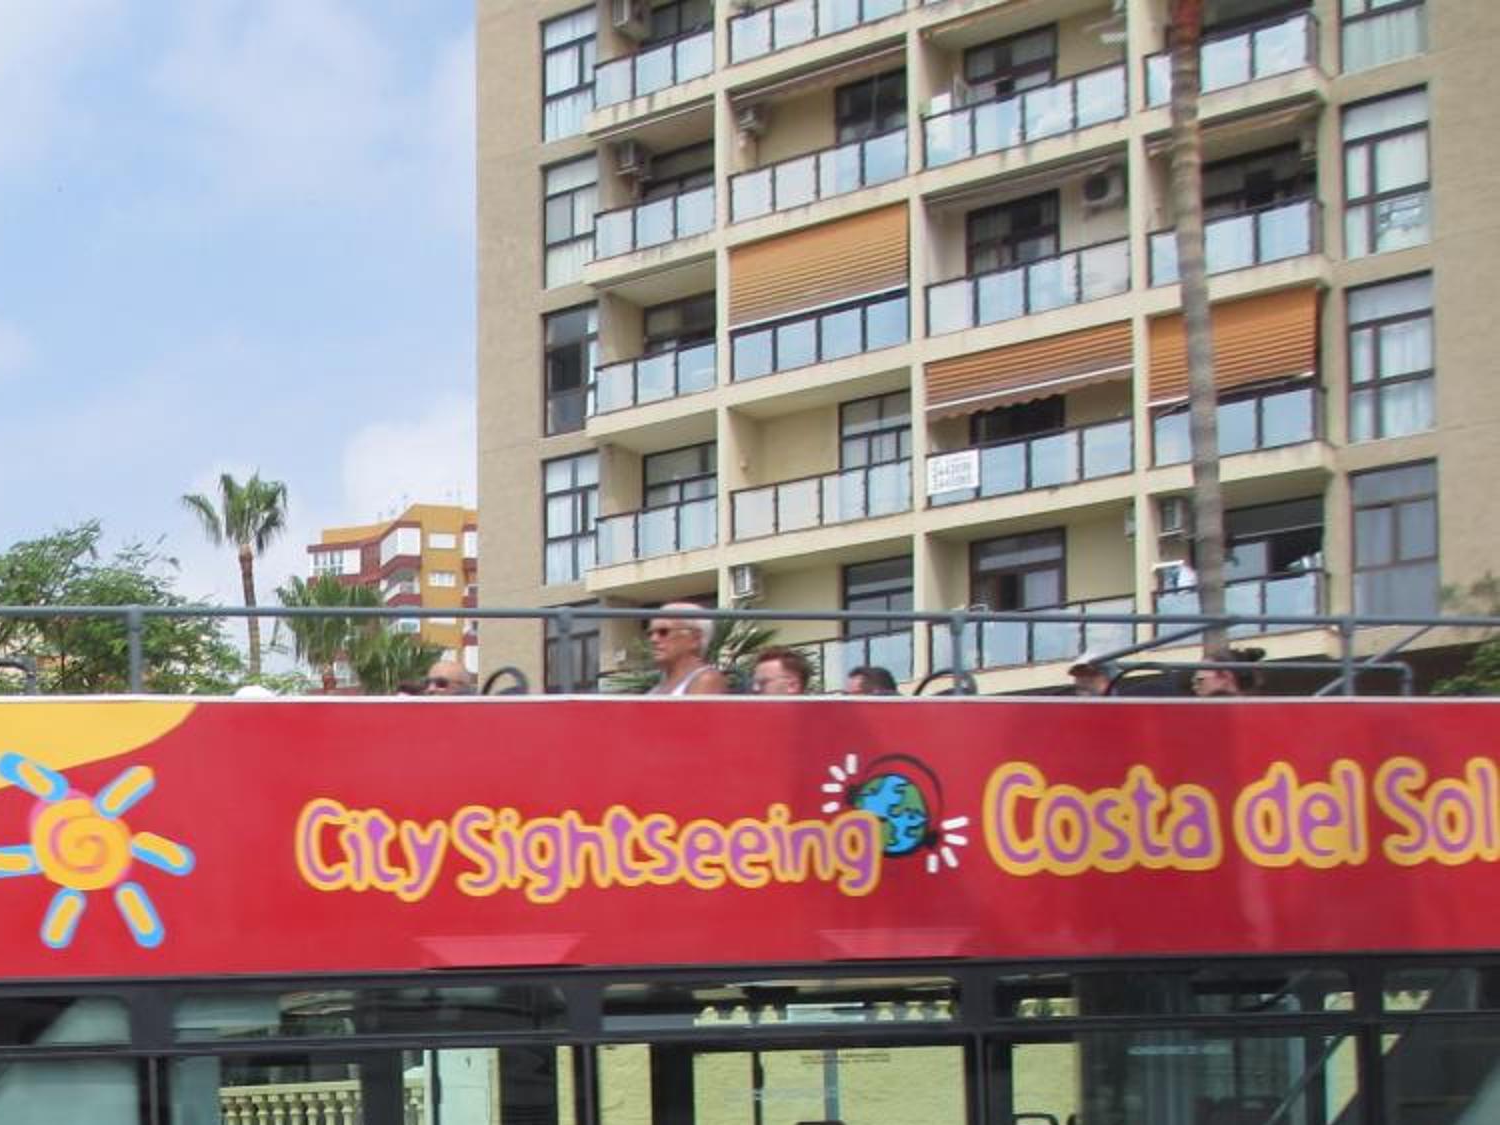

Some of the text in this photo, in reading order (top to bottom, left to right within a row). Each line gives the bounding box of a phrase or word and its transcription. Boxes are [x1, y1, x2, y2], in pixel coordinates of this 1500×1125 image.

[296, 797, 884, 904] City Sightseeing
[982, 755, 1499, 876] Costa del Sol
